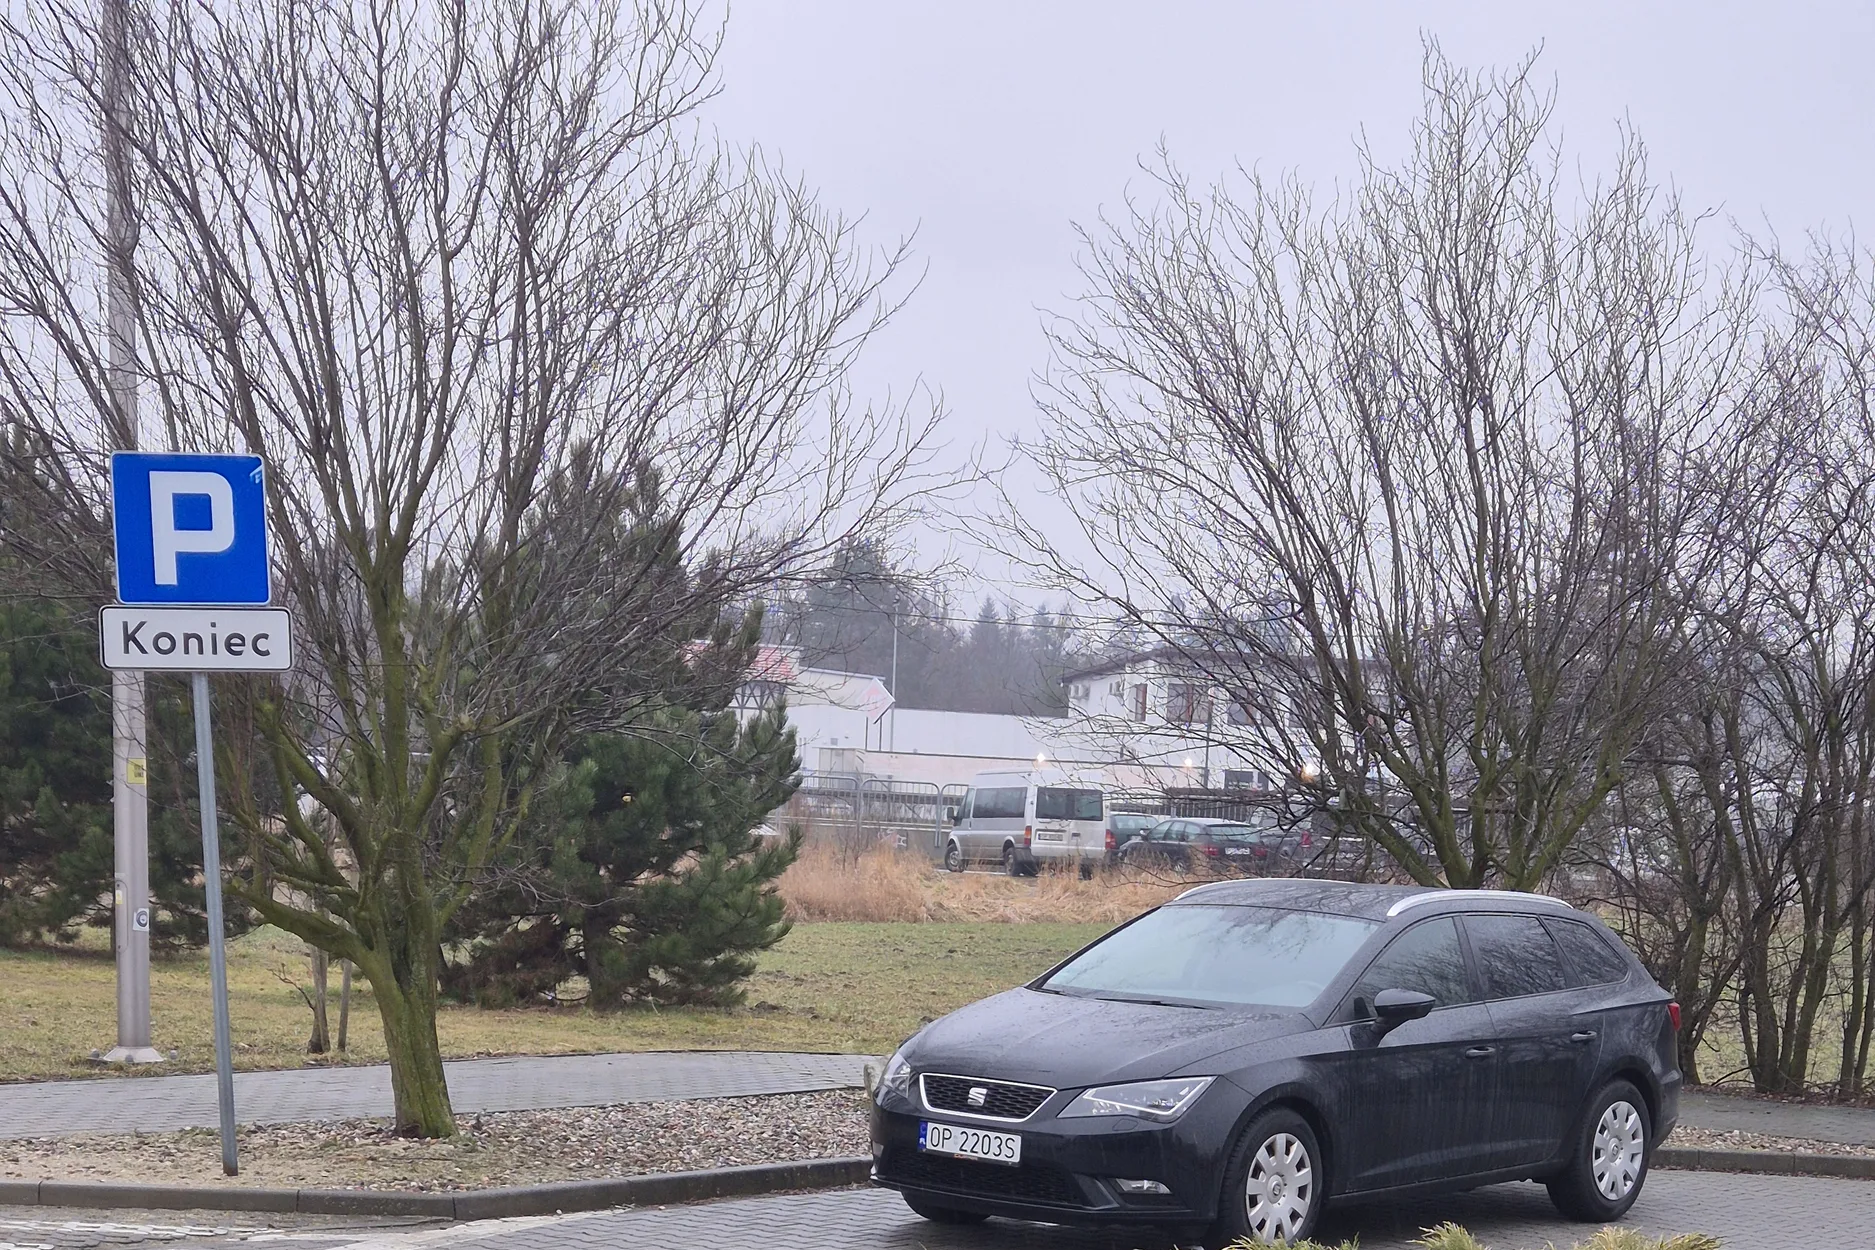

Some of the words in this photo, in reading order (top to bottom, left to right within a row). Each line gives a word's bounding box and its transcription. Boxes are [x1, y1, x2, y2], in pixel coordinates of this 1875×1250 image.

[149, 470, 235, 586] P
[121, 620, 271, 657] Koniec
[930, 1126, 952, 1149] OP
[959, 1130, 1016, 1159] 2203S
